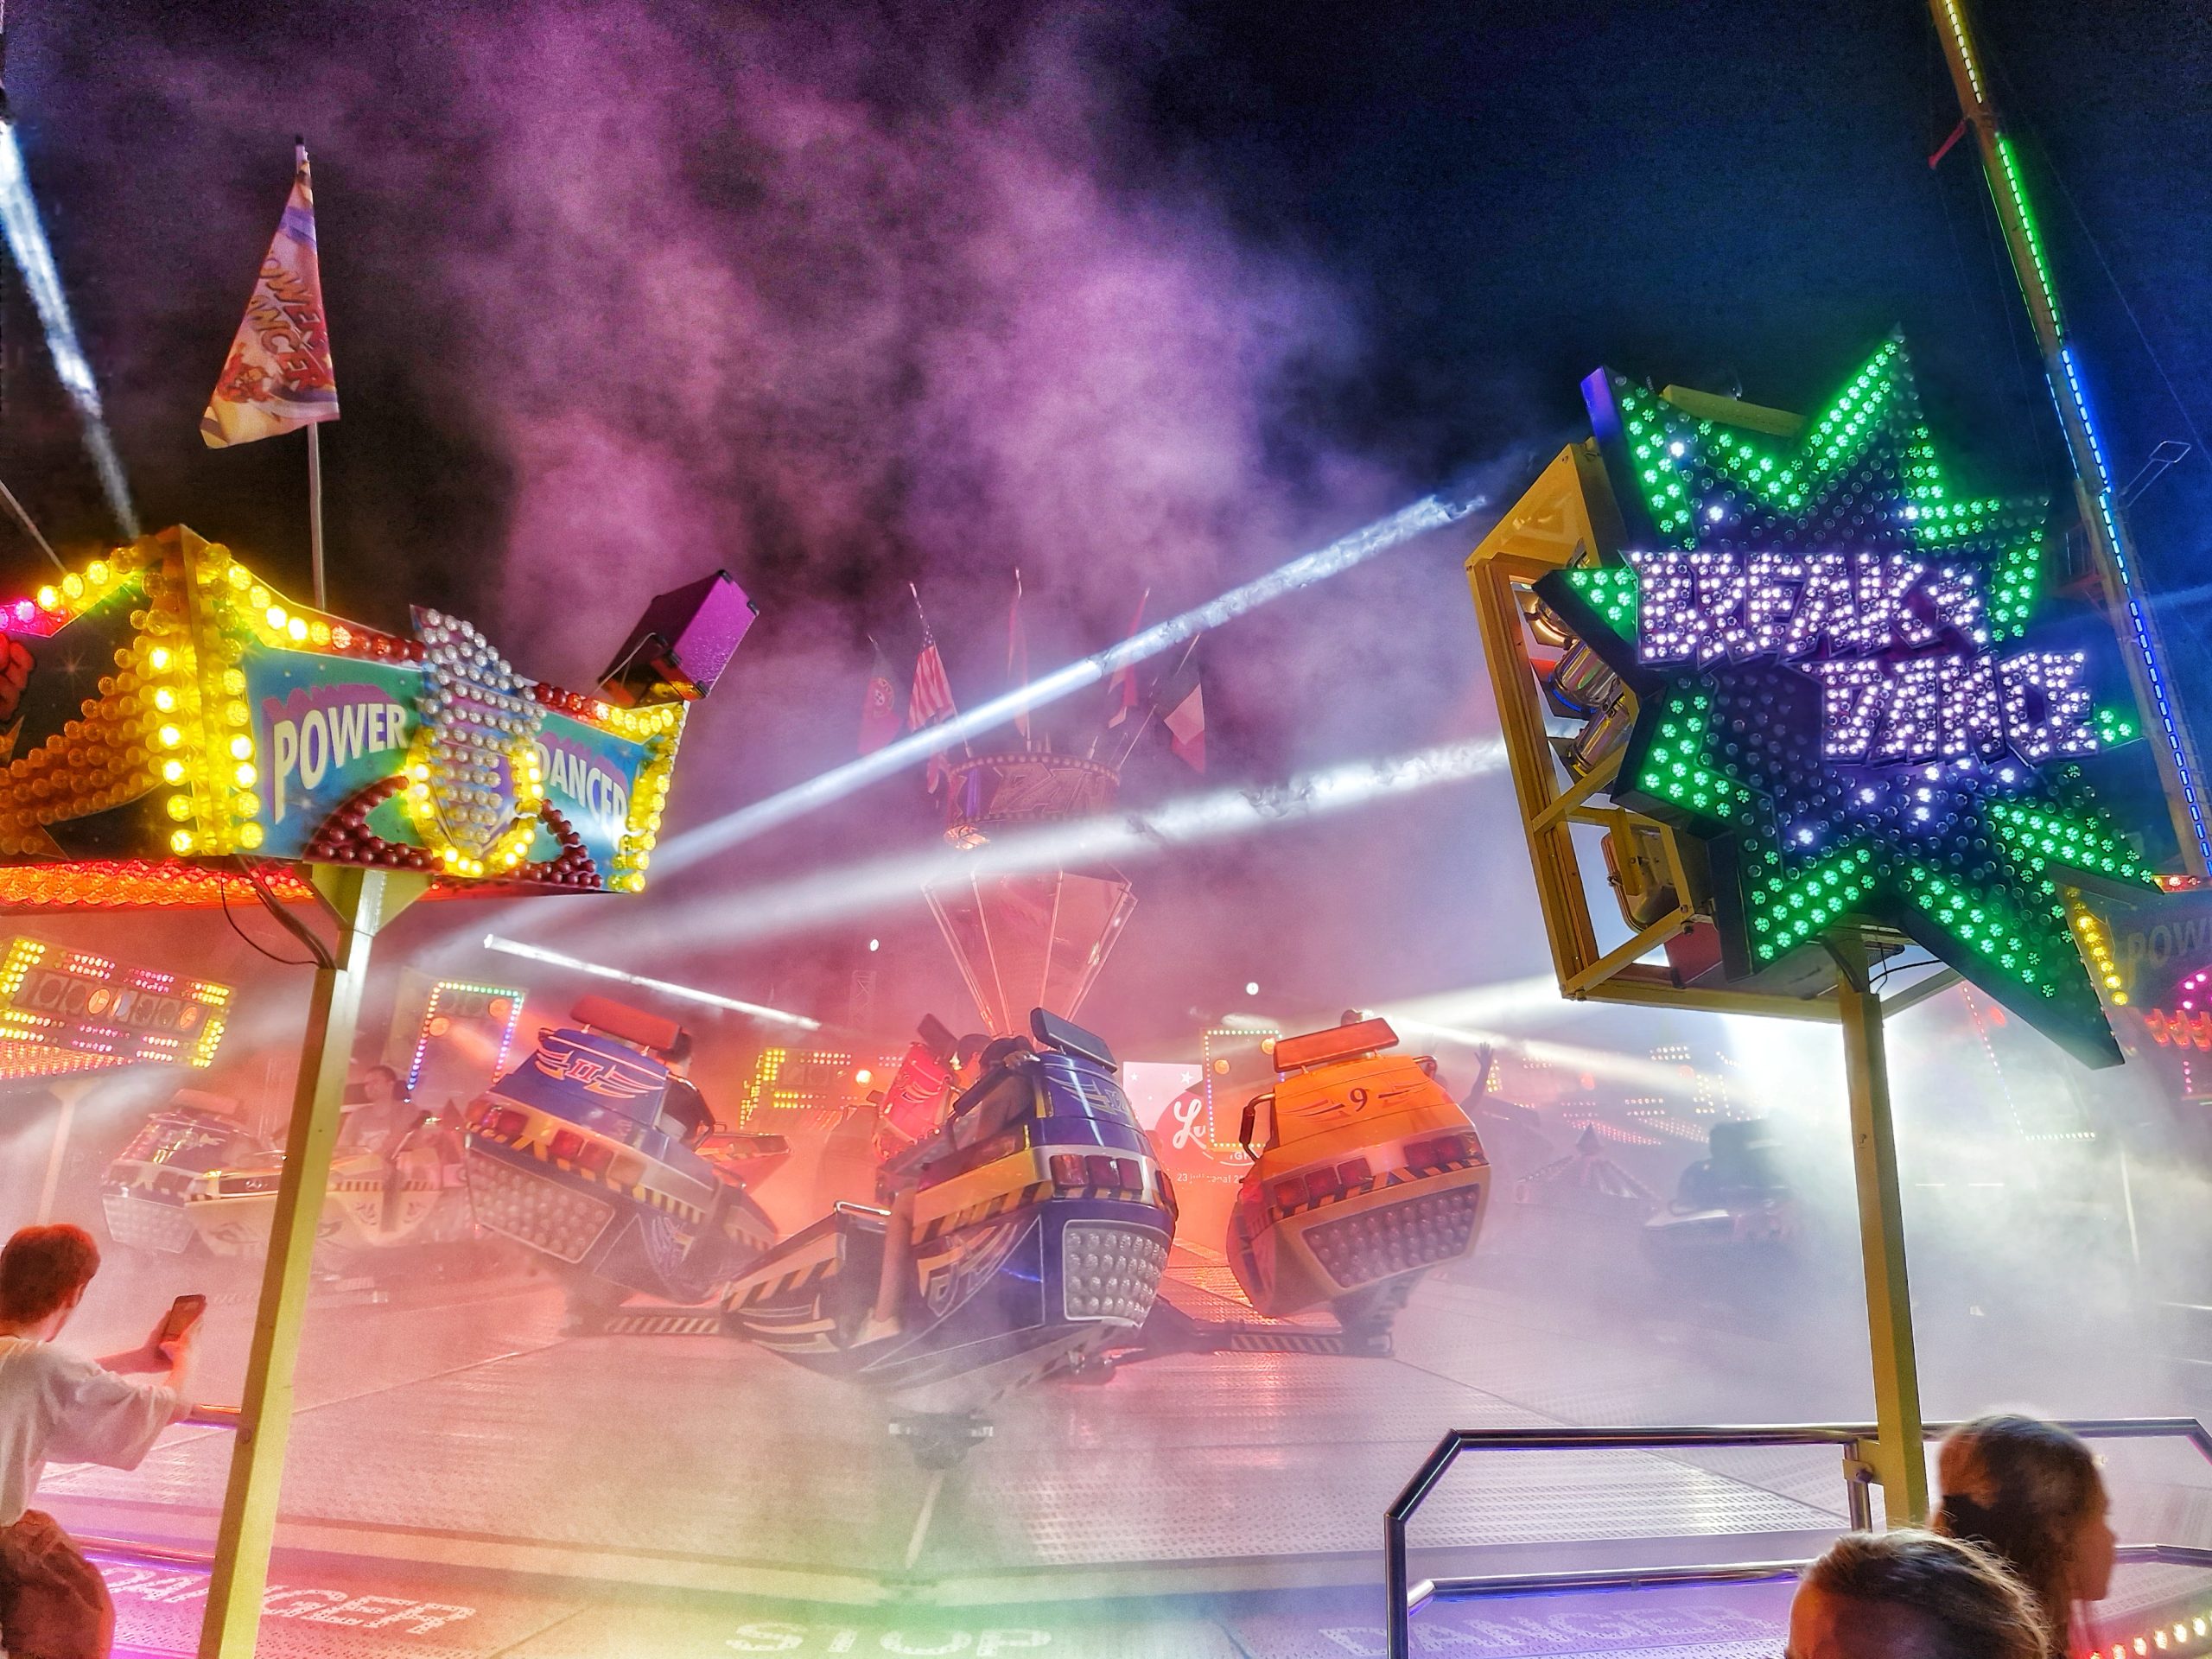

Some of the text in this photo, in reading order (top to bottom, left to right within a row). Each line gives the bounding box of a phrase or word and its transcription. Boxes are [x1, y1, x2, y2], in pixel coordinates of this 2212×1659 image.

[1619, 550, 1939, 671] BREAK
[1782, 650, 2101, 767] DANCE
[273, 702, 629, 852] POWER DANCER
[2126, 917, 2212, 989] POW
[1349, 1087, 1369, 1112] 9
